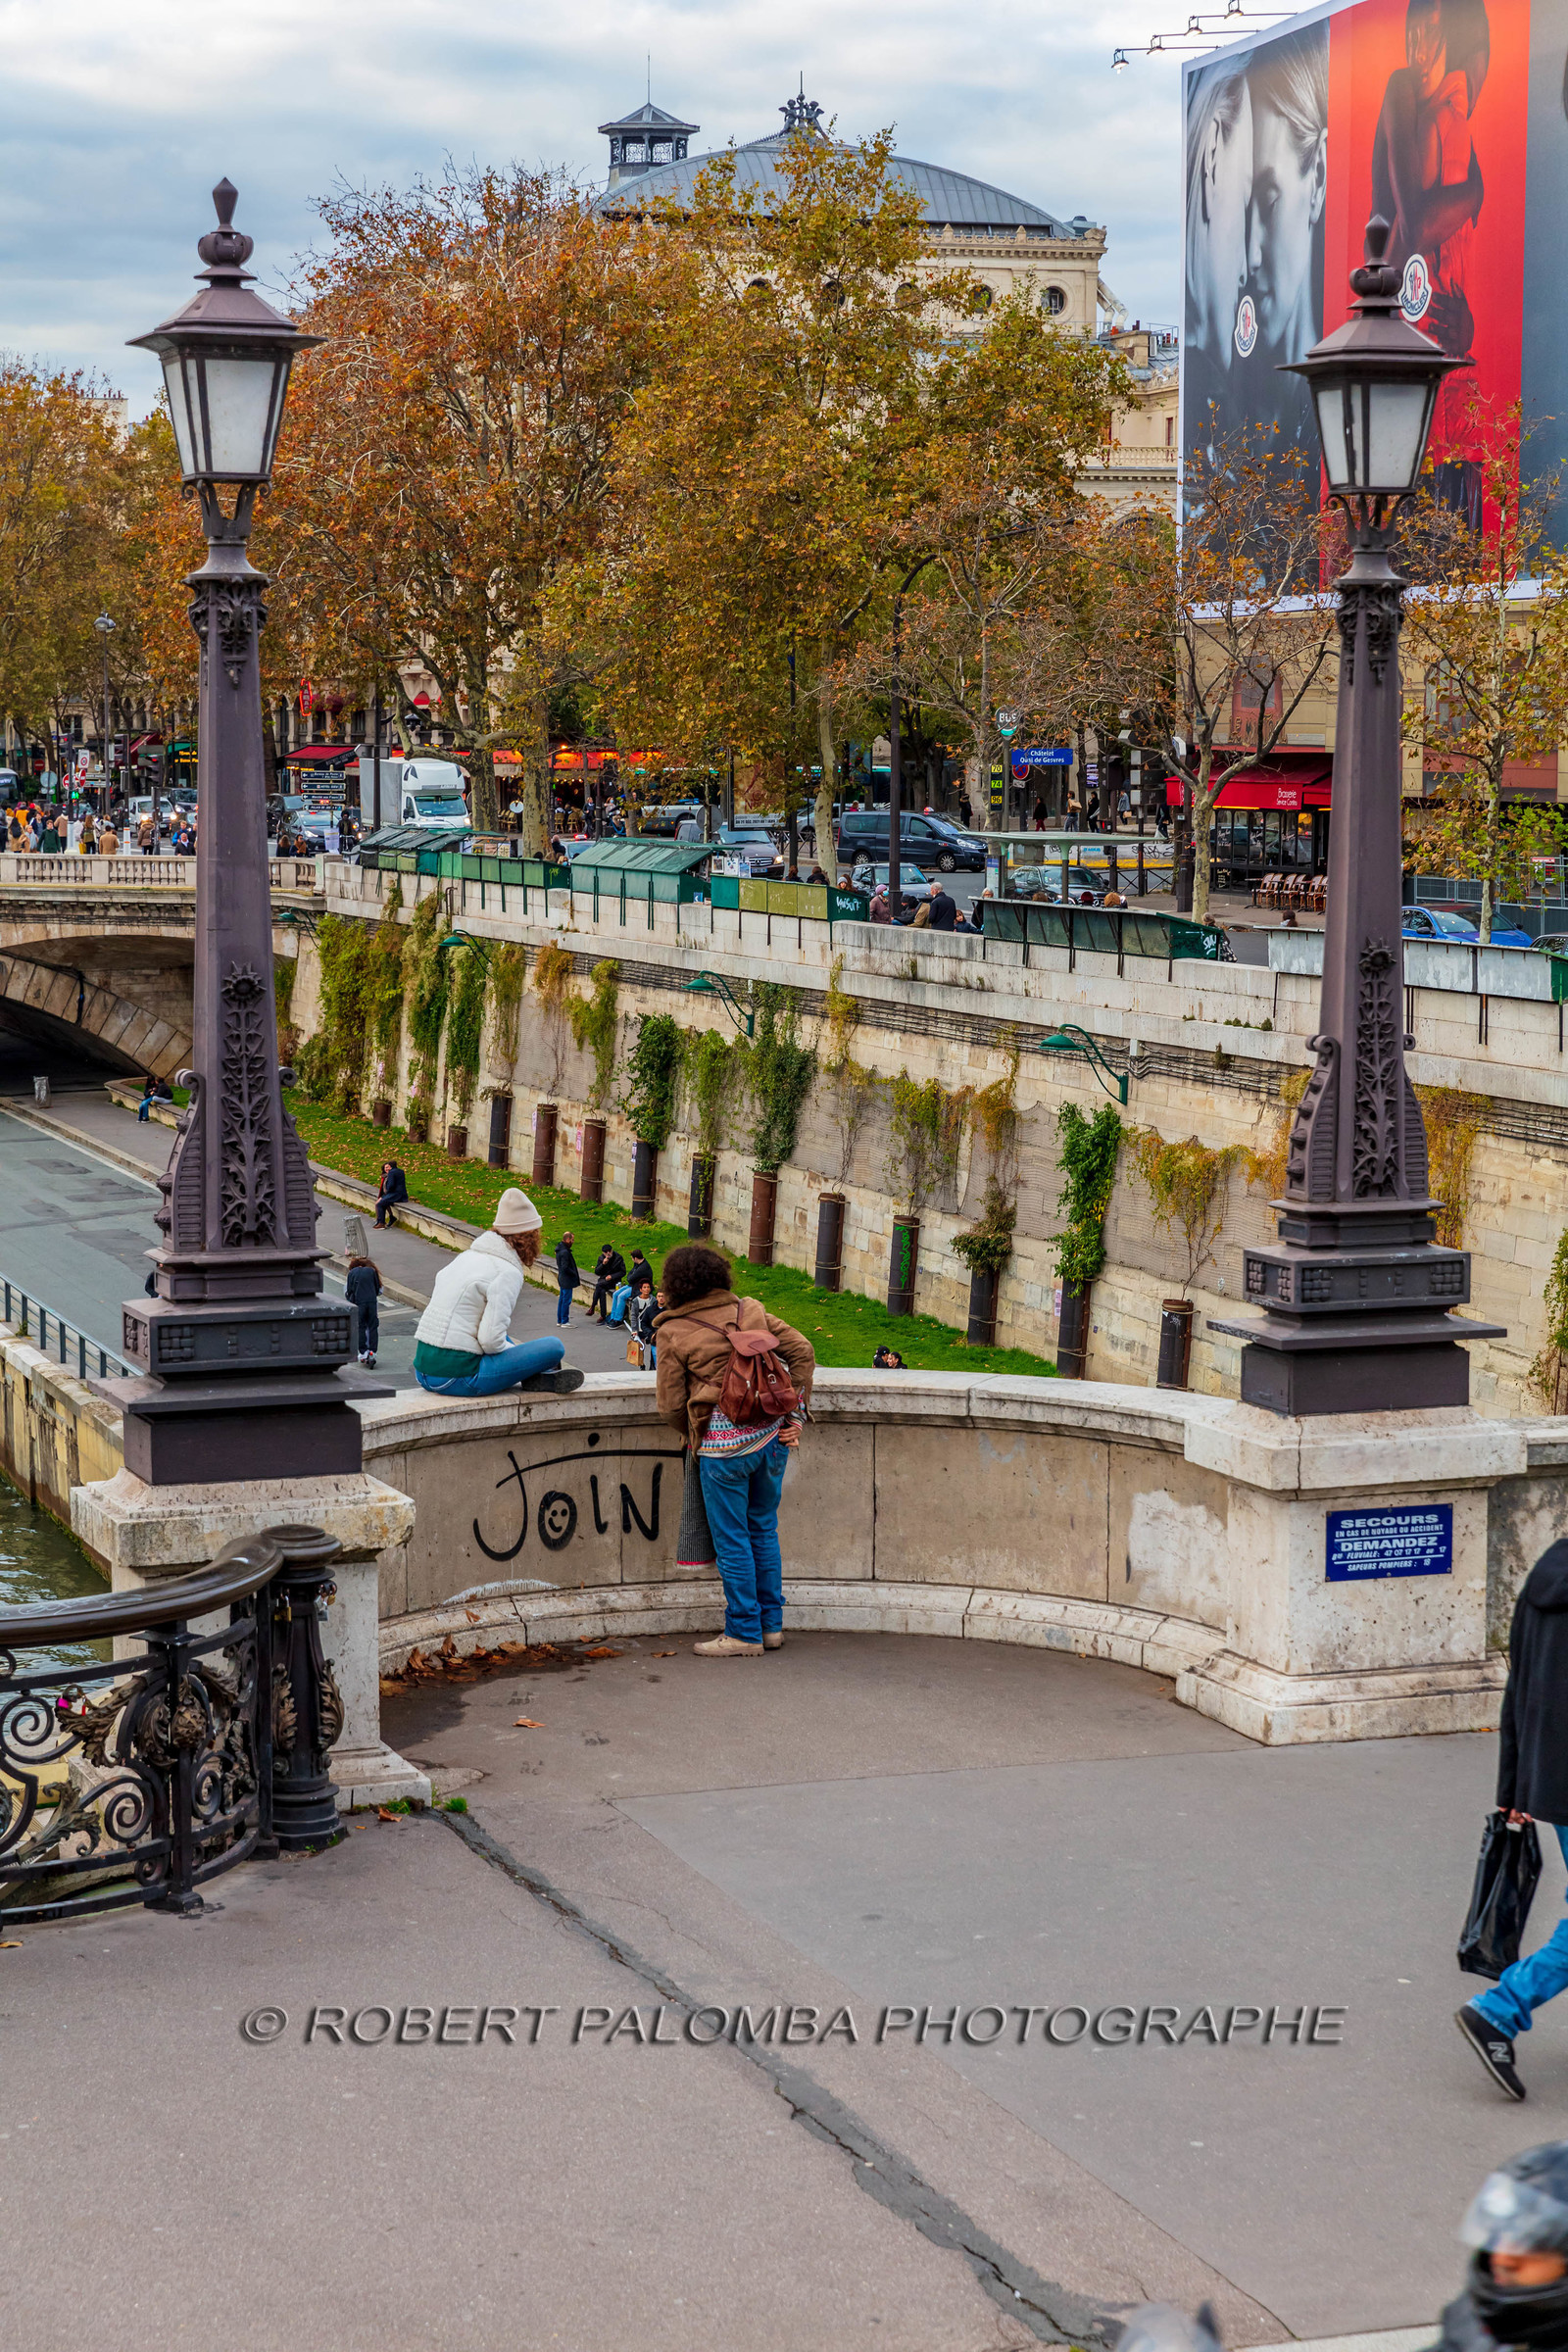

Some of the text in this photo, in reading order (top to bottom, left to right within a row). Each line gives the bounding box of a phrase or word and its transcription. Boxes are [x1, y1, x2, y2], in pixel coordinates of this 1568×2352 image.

[1340, 1514, 1439, 1529] SECOURS
[1335, 1530, 1346, 1539] EN
[1347, 1529, 1359, 1538] CAS
[1360, 1528, 1370, 1537] DE
[1371, 1527, 1397, 1536] NOYADE
[1410, 1524, 1444, 1533] ACCIDENT
[1341, 1536, 1438, 1552] DEMANDEZ
[1394, 1548, 1402, 1557] 07
[1348, 1561, 1376, 1572] SAPEURS
[1378, 1559, 1413, 1569] POMPIERS
